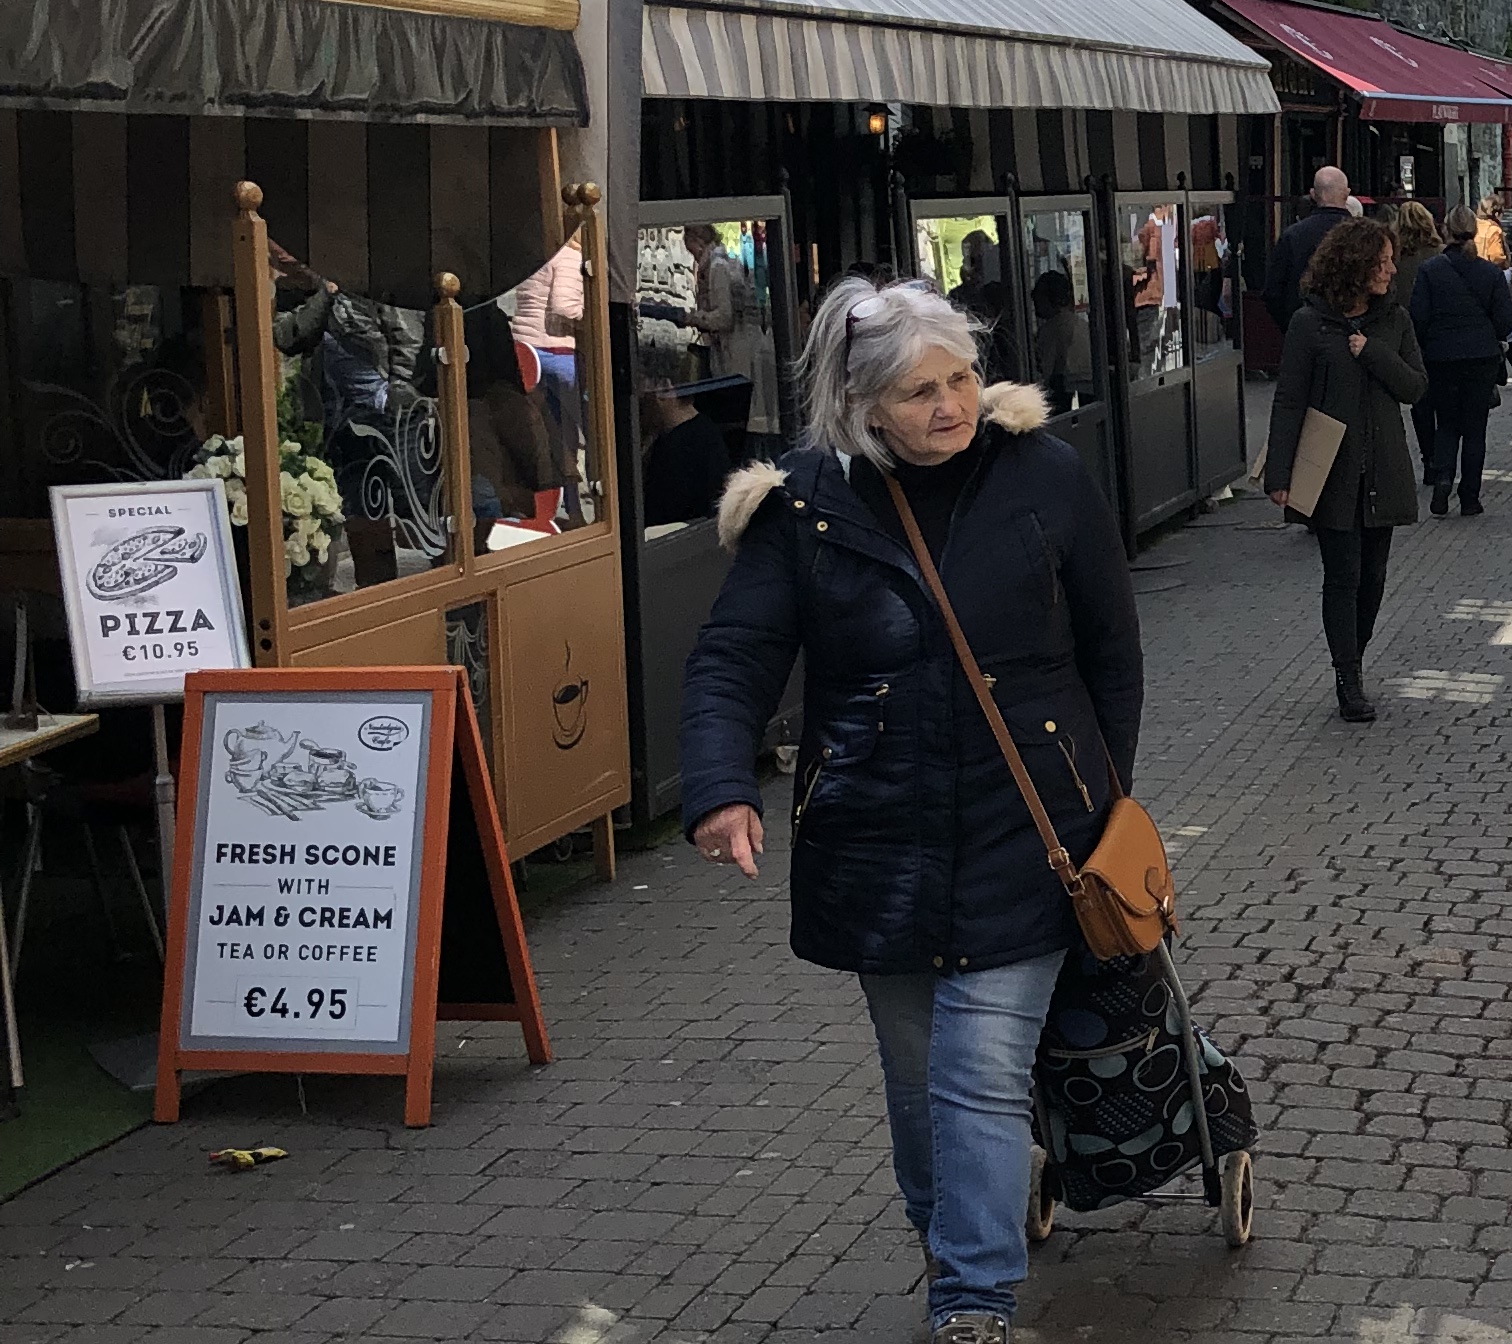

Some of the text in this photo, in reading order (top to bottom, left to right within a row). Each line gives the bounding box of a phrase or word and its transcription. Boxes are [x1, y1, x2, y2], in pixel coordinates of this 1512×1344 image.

[108, 505, 172, 518] SPECIAL
[100, 608, 215, 638] PIZZA
[122, 641, 199, 661] €10.95
[215, 843, 397, 867] FRESH SCONE
[277, 877, 330, 895] WITH
[208, 904, 393, 930] JAM & CREAM
[217, 942, 378, 962] TEA OR COFFEE
[243, 986, 348, 1020] €4.95
